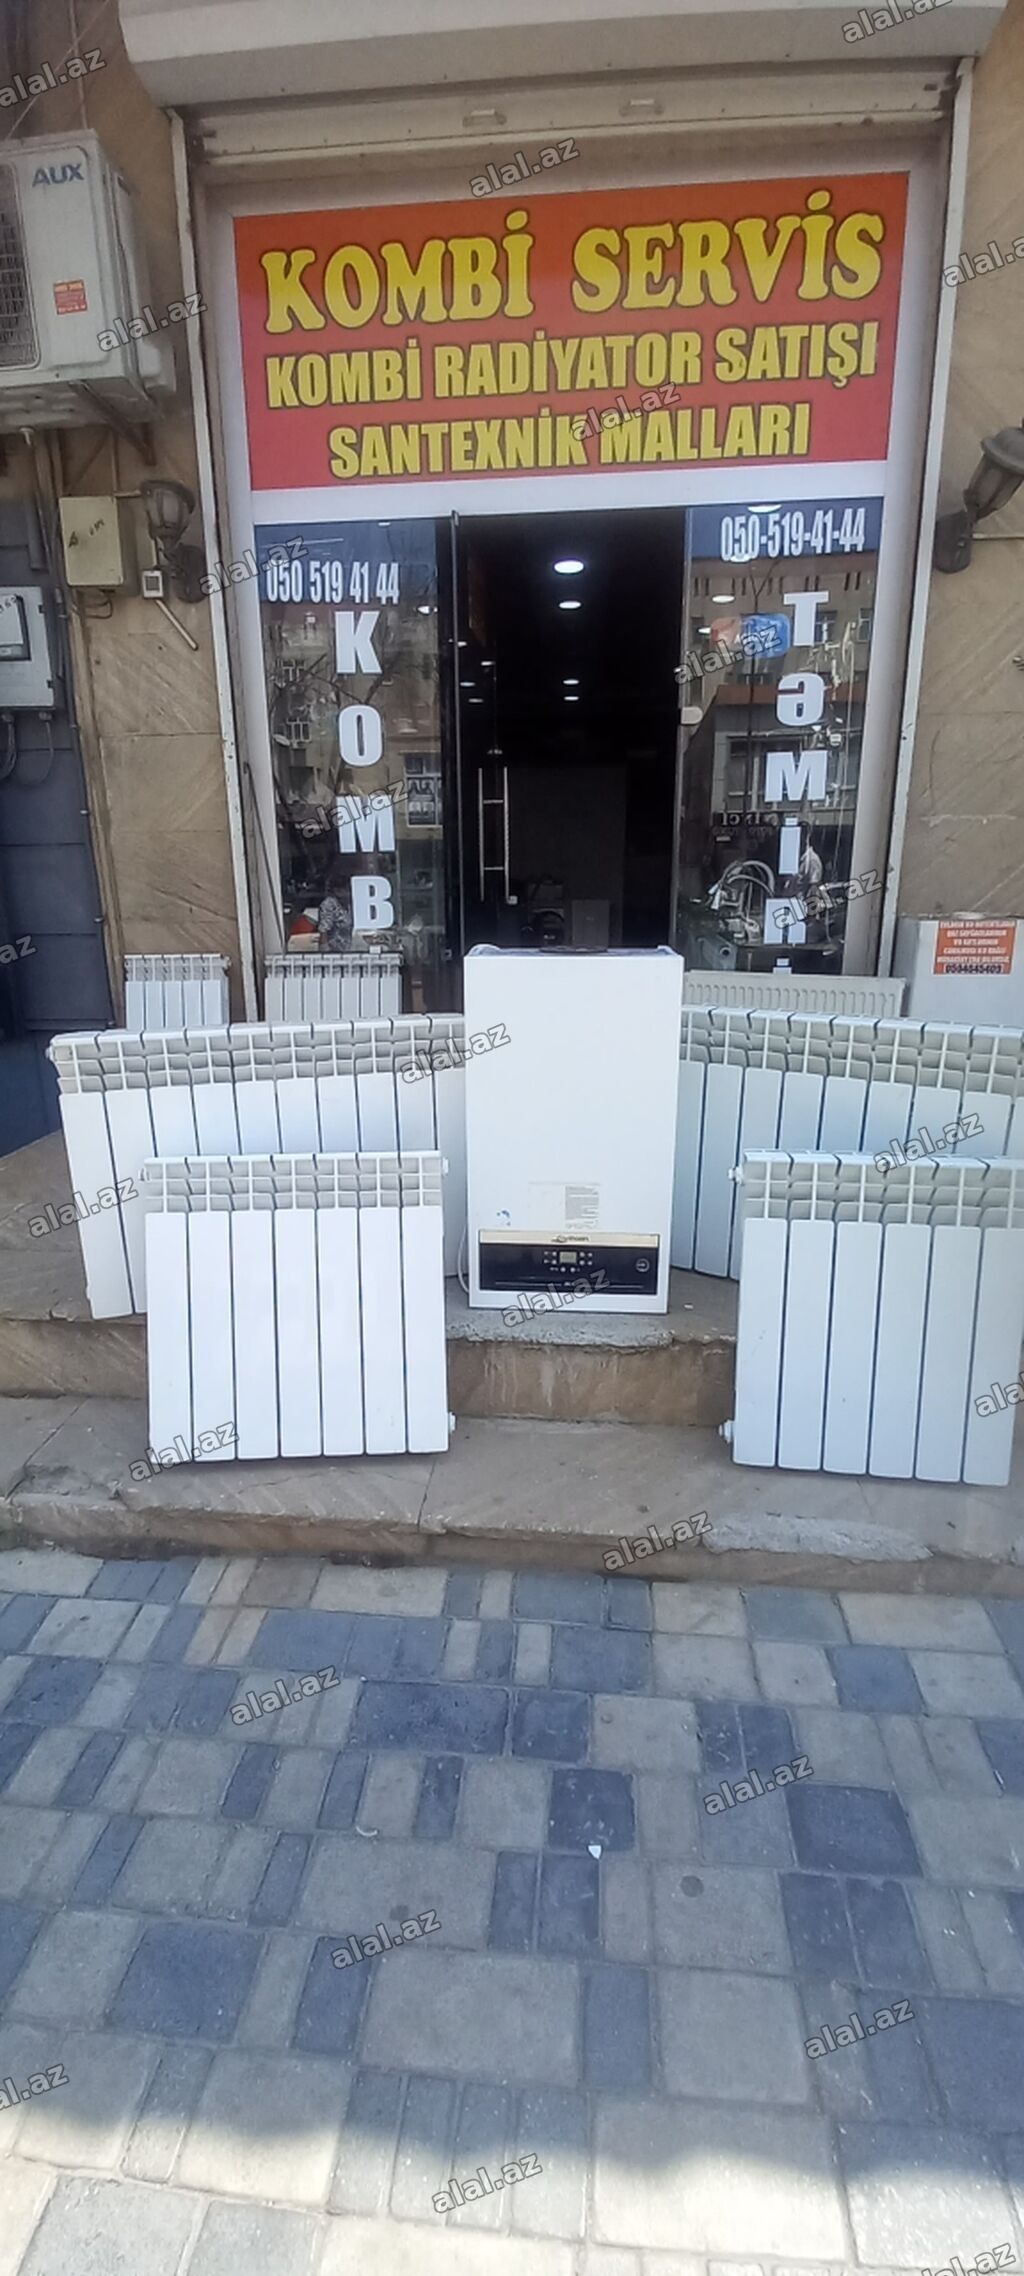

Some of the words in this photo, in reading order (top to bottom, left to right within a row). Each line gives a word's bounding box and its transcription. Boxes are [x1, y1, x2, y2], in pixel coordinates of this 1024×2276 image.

[32, 163, 84, 188] AUX
[260, 211, 534, 333] KOMBİ
[572, 190, 885, 313] SERVİS
[266, 339, 423, 409] KOMBİ
[434, 329, 702, 398] RADİYATOR
[715, 321, 879, 388] SATIŞI
[329, 408, 587, 478] SANTEXNİK
[600, 403, 811, 464] MALLARI
[721, 507, 865, 560] 050-519-41-44
[266, 560, 303, 604] 050
[309, 560, 342, 604] 519
[349, 560, 370, 603] 41
[376, 560, 399, 605] 44
[334, 611, 395, 953] KOMB
